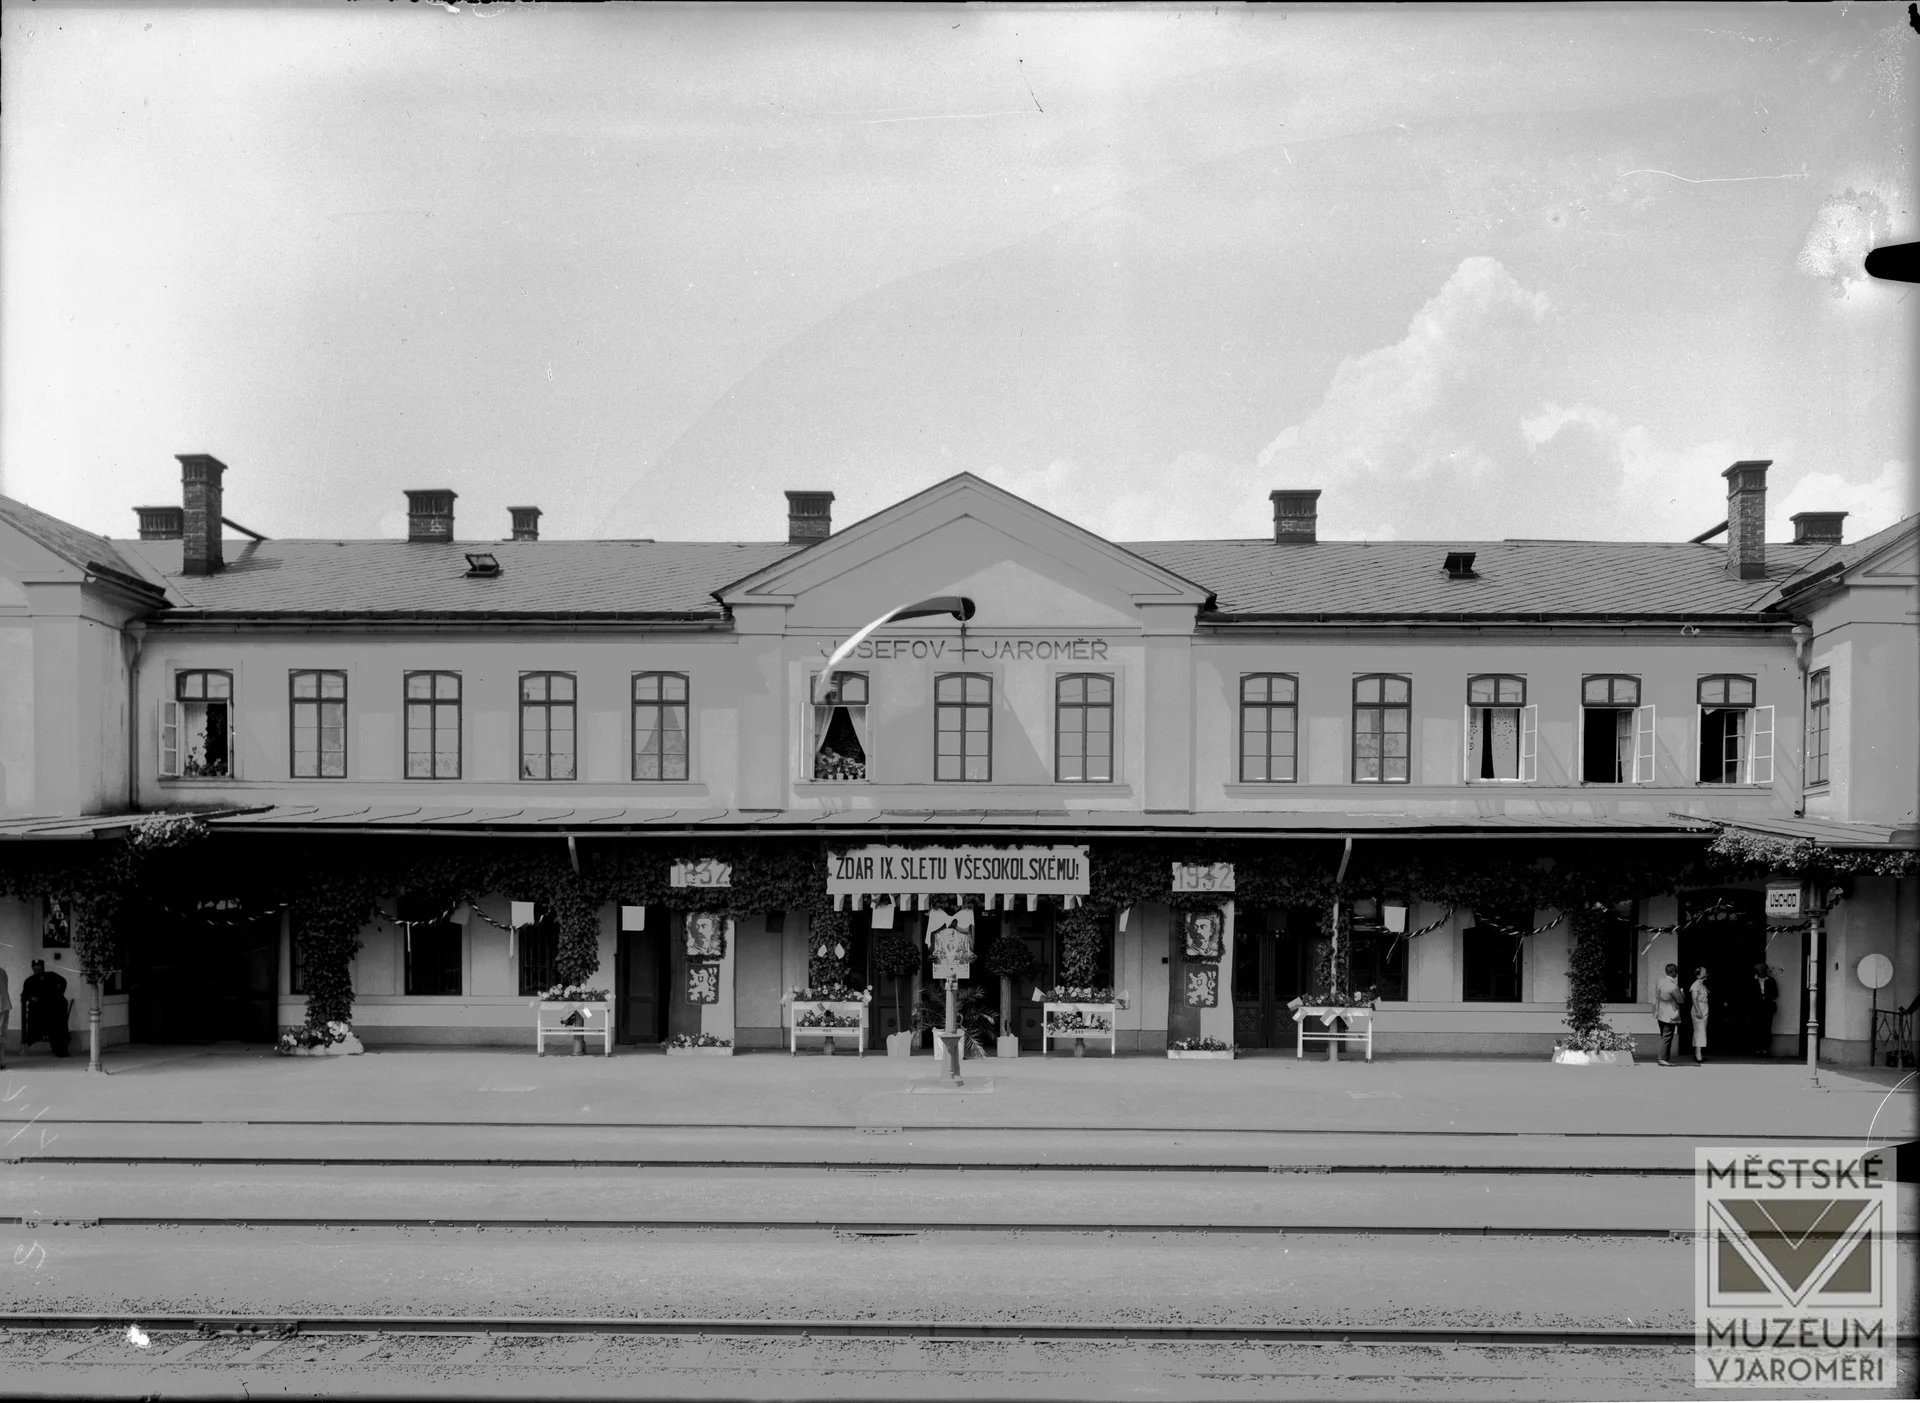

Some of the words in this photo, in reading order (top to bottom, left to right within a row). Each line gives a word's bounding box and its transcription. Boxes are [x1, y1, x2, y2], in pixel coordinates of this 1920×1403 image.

[836, 857, 873, 880] ZDAR
[880, 857, 898, 880] IX.
[901, 857, 947, 880] SLETU
[954, 854, 1079, 881] VŠESOKOLSKÉMU!
